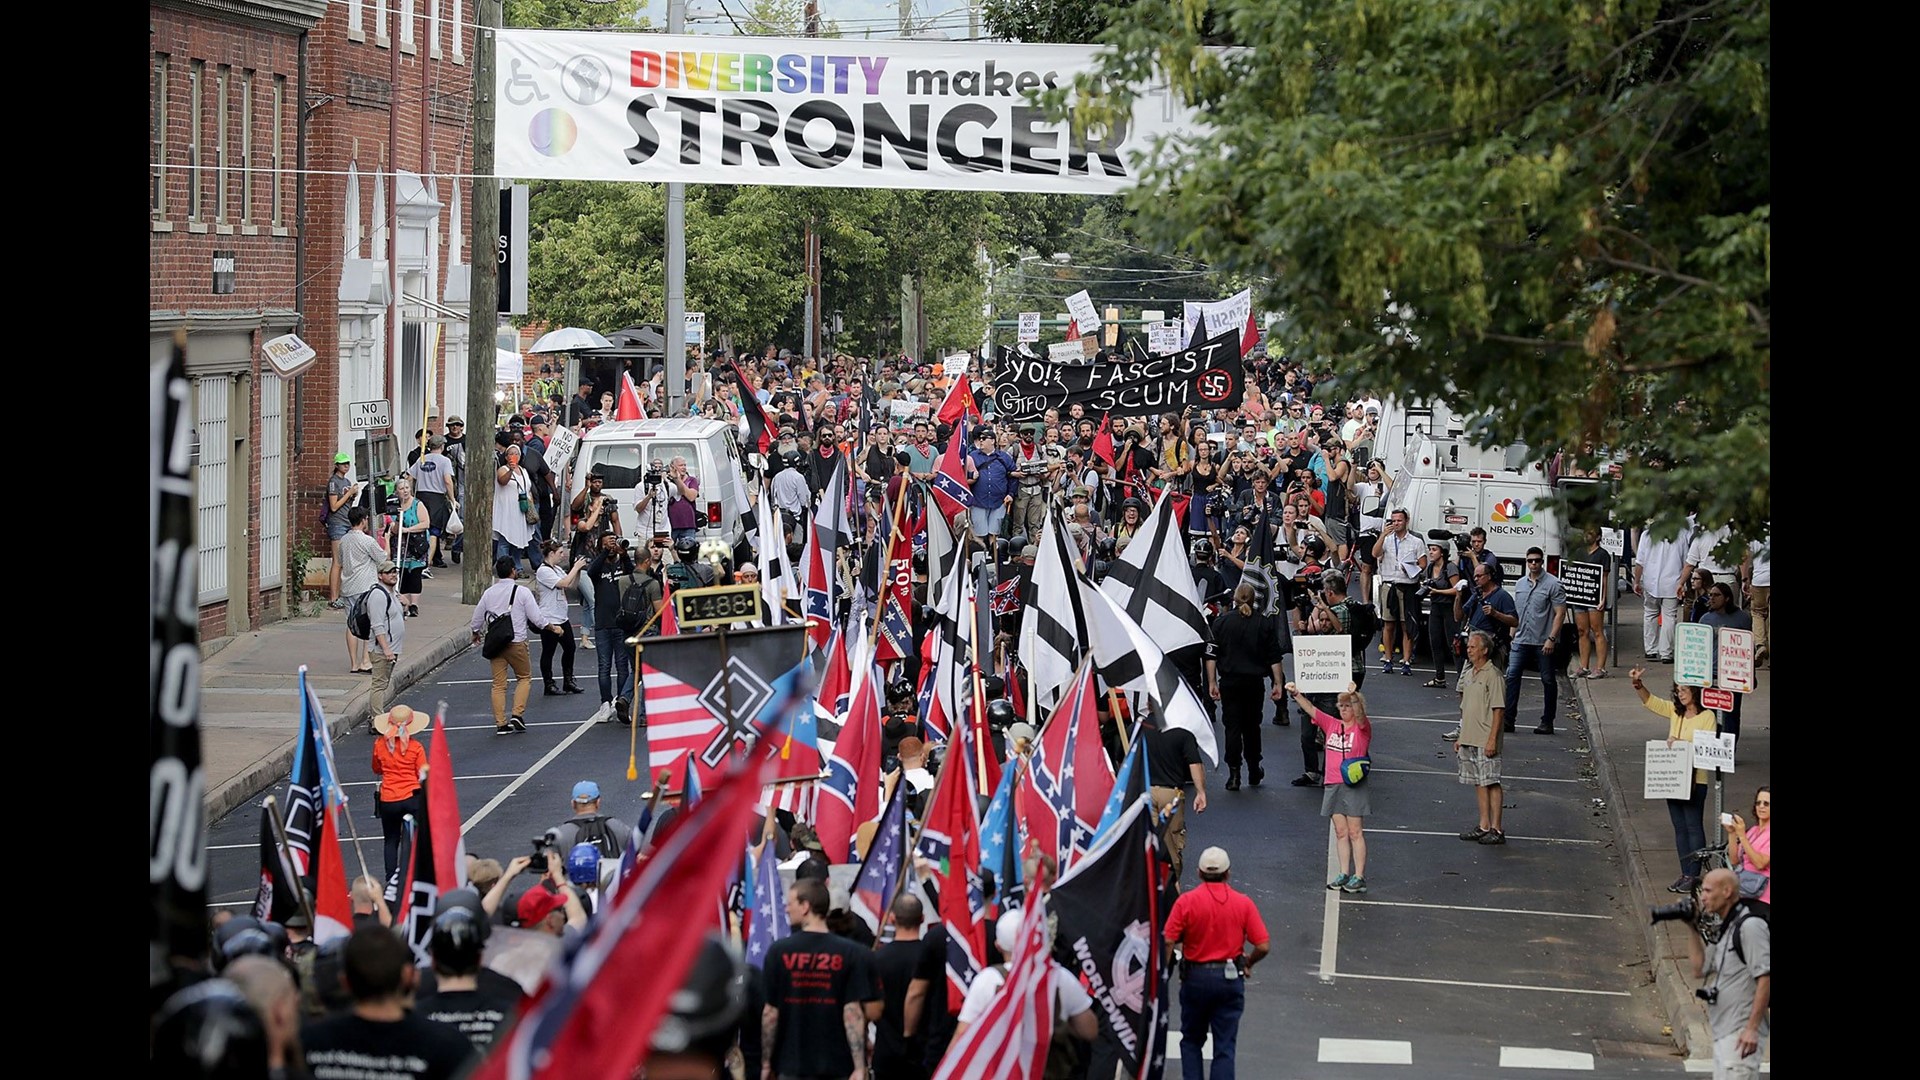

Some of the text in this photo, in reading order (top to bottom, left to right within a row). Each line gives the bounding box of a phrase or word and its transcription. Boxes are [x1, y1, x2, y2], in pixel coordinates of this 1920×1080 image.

[630, 50, 889, 95] DIVERSITY
[623, 93, 1128, 177] STRONGER
[1011, 359, 1052, 386] YO!
[1087, 343, 1223, 389] FASCIST
[1091, 380, 1190, 410] SCUM
[362, 403, 377, 414] NO
[1002, 391, 1047, 414] GTFO
[353, 415, 387, 427] IDLING
[561, 431, 573, 442] NO
[551, 437, 572, 454] NAZIS
[555, 450, 563, 458] IN
[550, 456, 559, 468] VA
[1490, 526, 1534, 536] NBC NEWS
[1577, 567, 1594, 575] decided
[690, 594, 748, 619] 1488
[1729, 633, 1743, 646] NO
[1298, 649, 1316, 657] STOP
[1721, 645, 1751, 660] PARKING
[1724, 660, 1748, 669] ANYTIME
[1300, 671, 1339, 680] Patriotism
[1694, 745, 1733, 760] NO PARKING
[782, 952, 843, 971] VF/28
